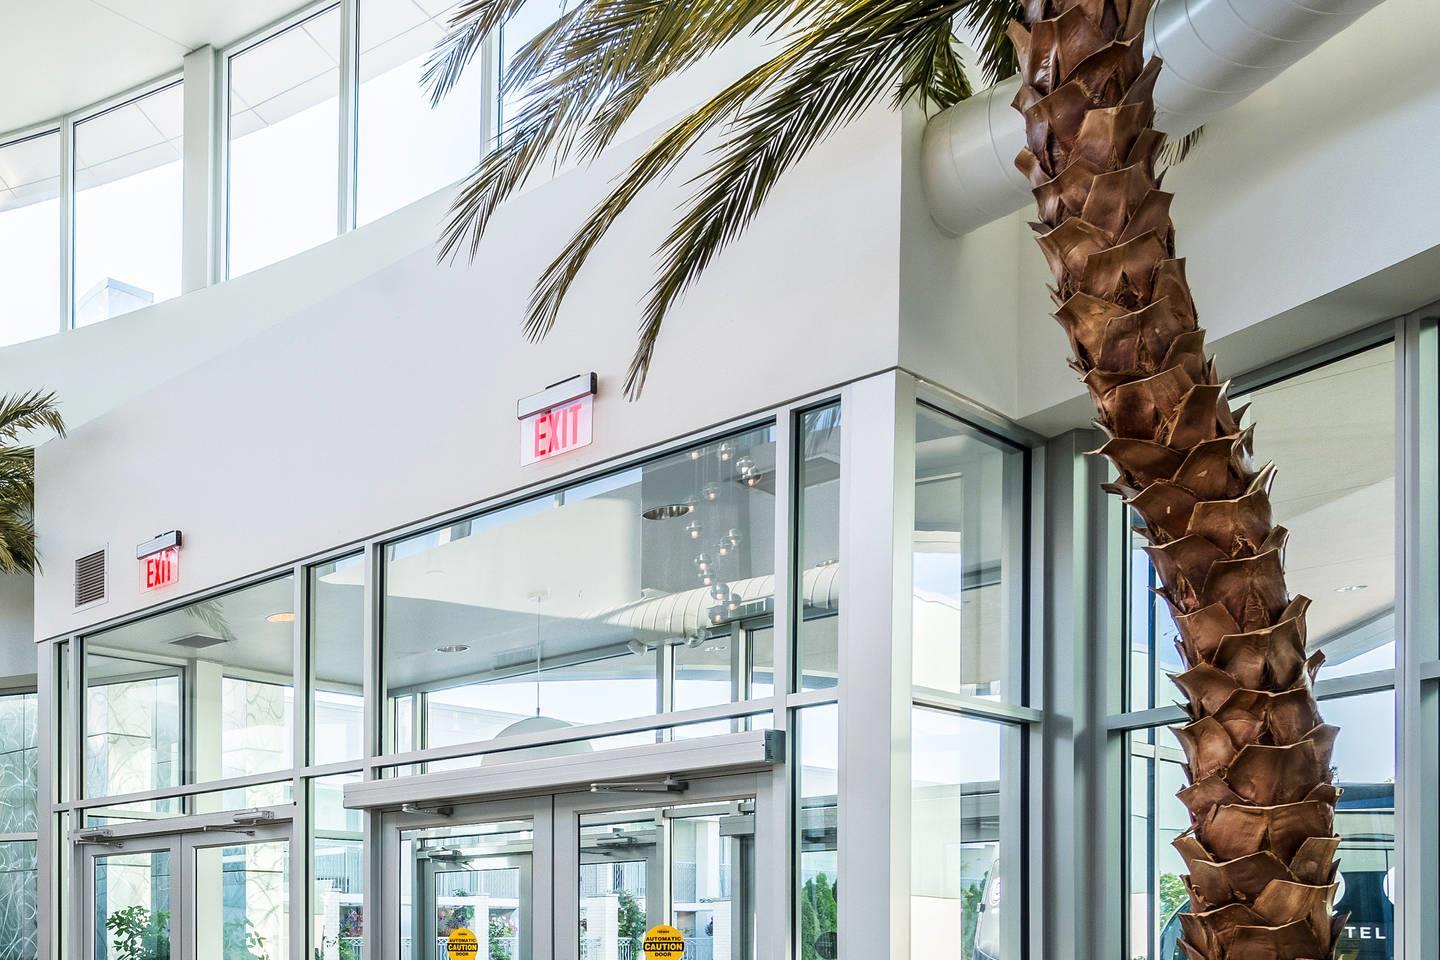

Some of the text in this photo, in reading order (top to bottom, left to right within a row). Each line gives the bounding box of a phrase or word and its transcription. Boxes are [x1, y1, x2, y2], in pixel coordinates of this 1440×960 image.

[534, 403, 582, 458] EXIT
[147, 555, 172, 588] EXIT
[644, 943, 682, 951] CAUTION
